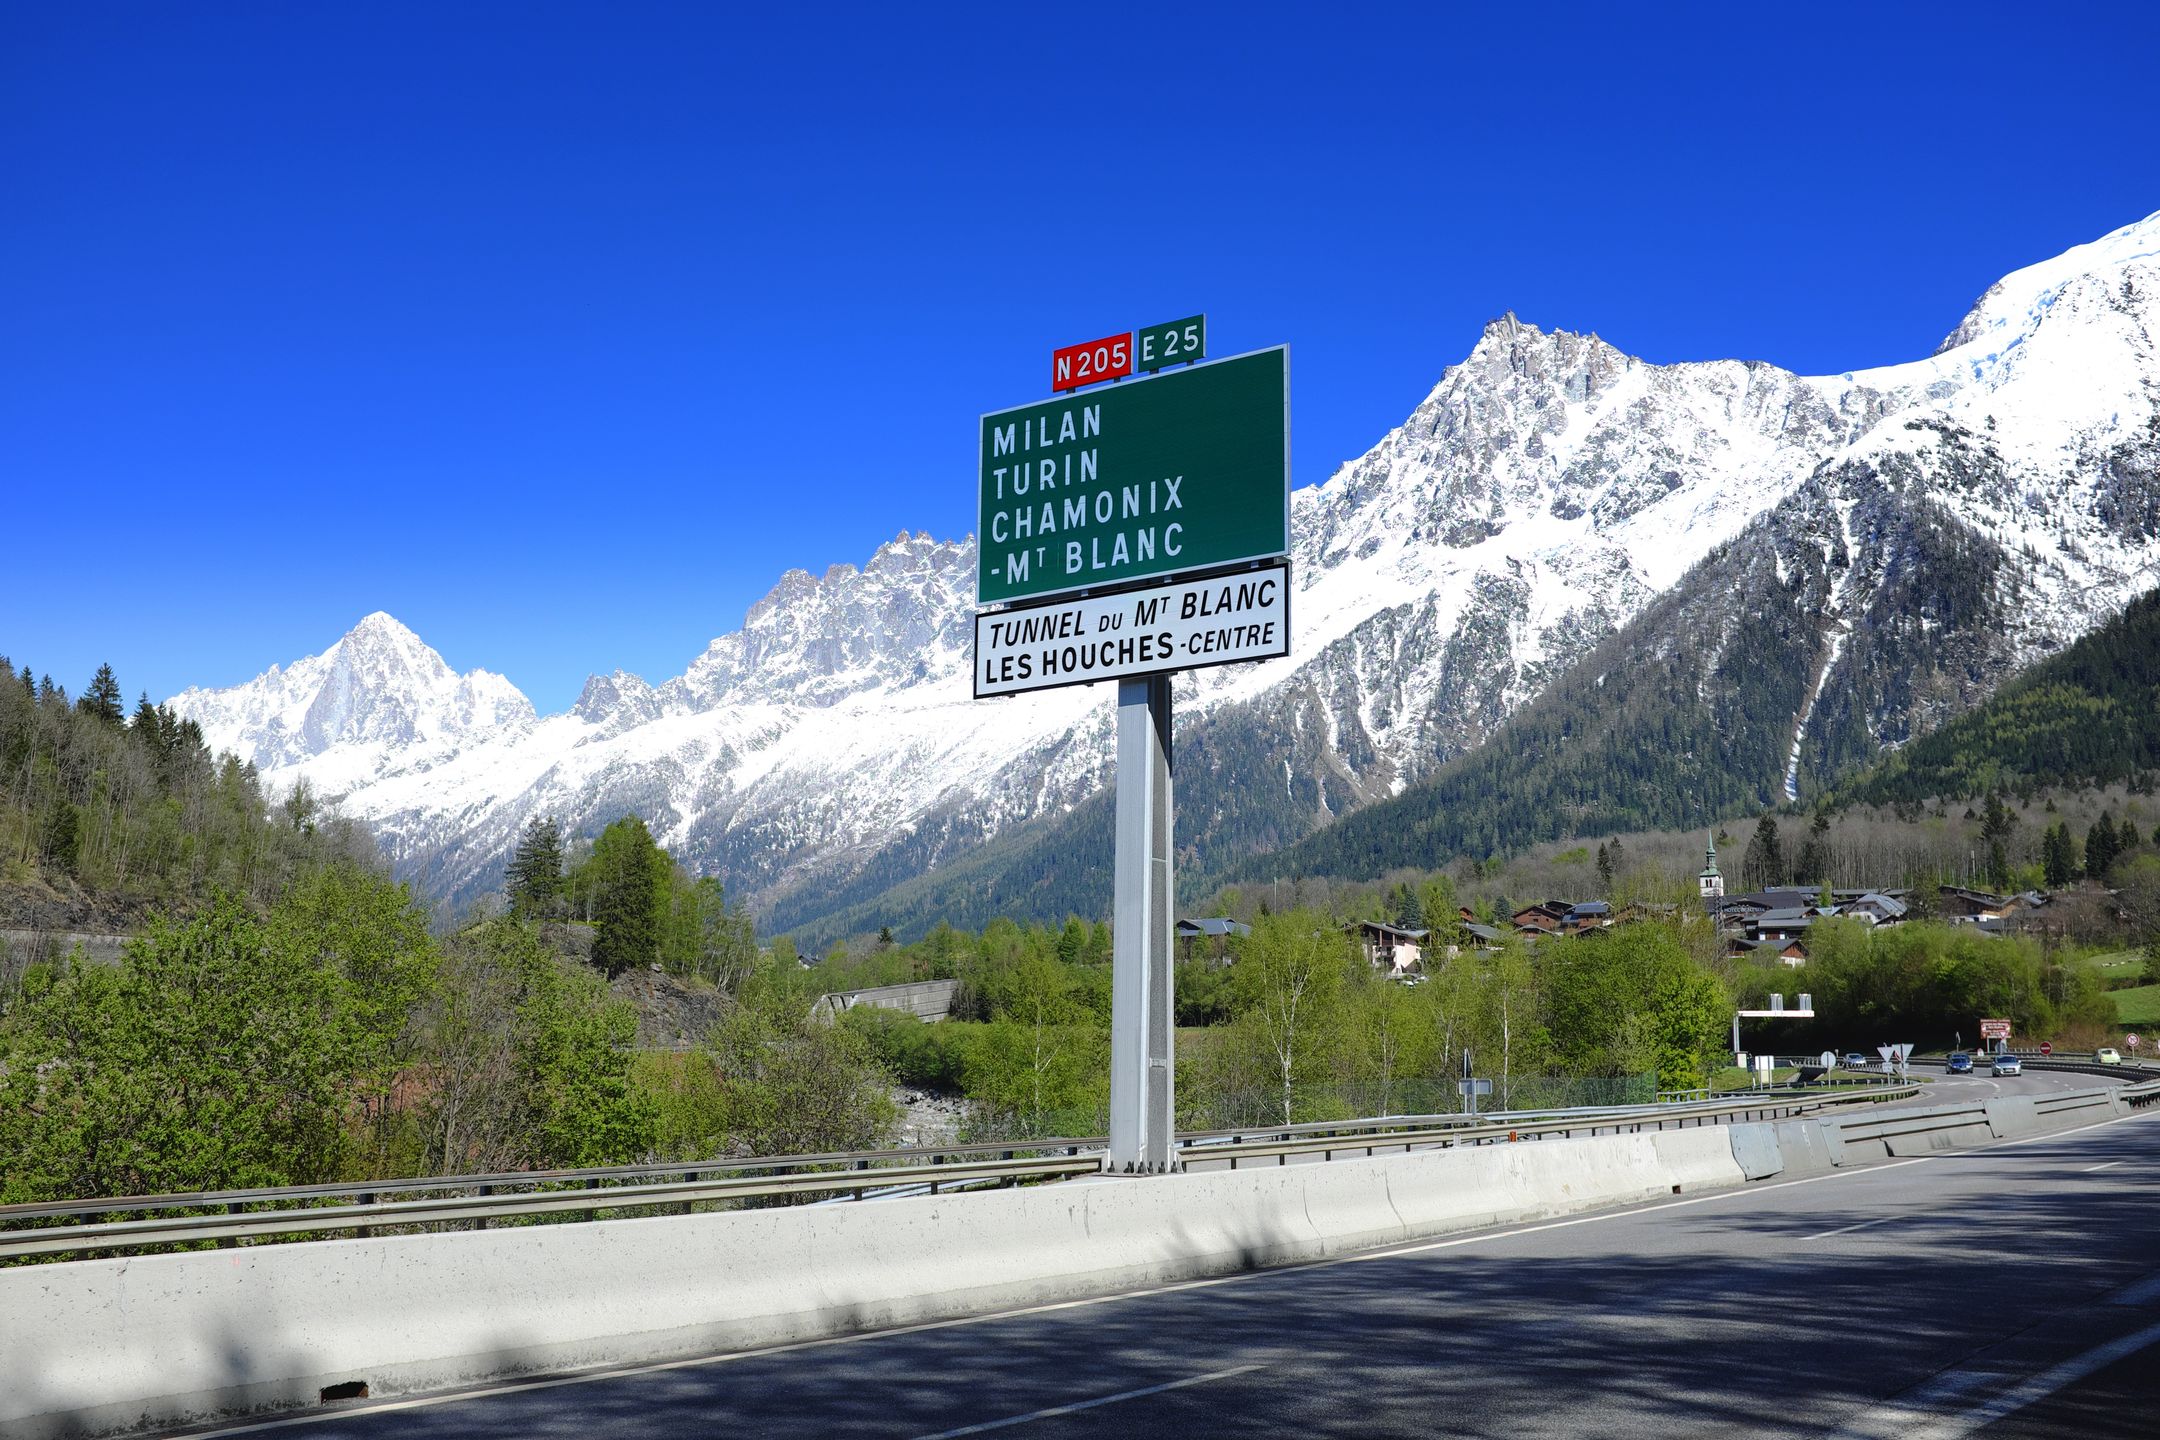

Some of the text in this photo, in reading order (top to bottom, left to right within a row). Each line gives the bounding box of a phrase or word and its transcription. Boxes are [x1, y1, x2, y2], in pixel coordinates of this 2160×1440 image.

[1057, 342, 1127, 382] N 205
[1143, 324, 1199, 362] E 25
[993, 404, 1101, 457] MILAN
[993, 448, 1098, 499] TURIN
[991, 475, 1183, 543] CHAMONIX
[1065, 522, 1183, 574] BLANC
[990, 610, 1085, 649] TUNNEL
[1098, 613, 1123, 633] DU
[1180, 579, 1276, 620] BLANC
[986, 653, 1032, 684] LES
